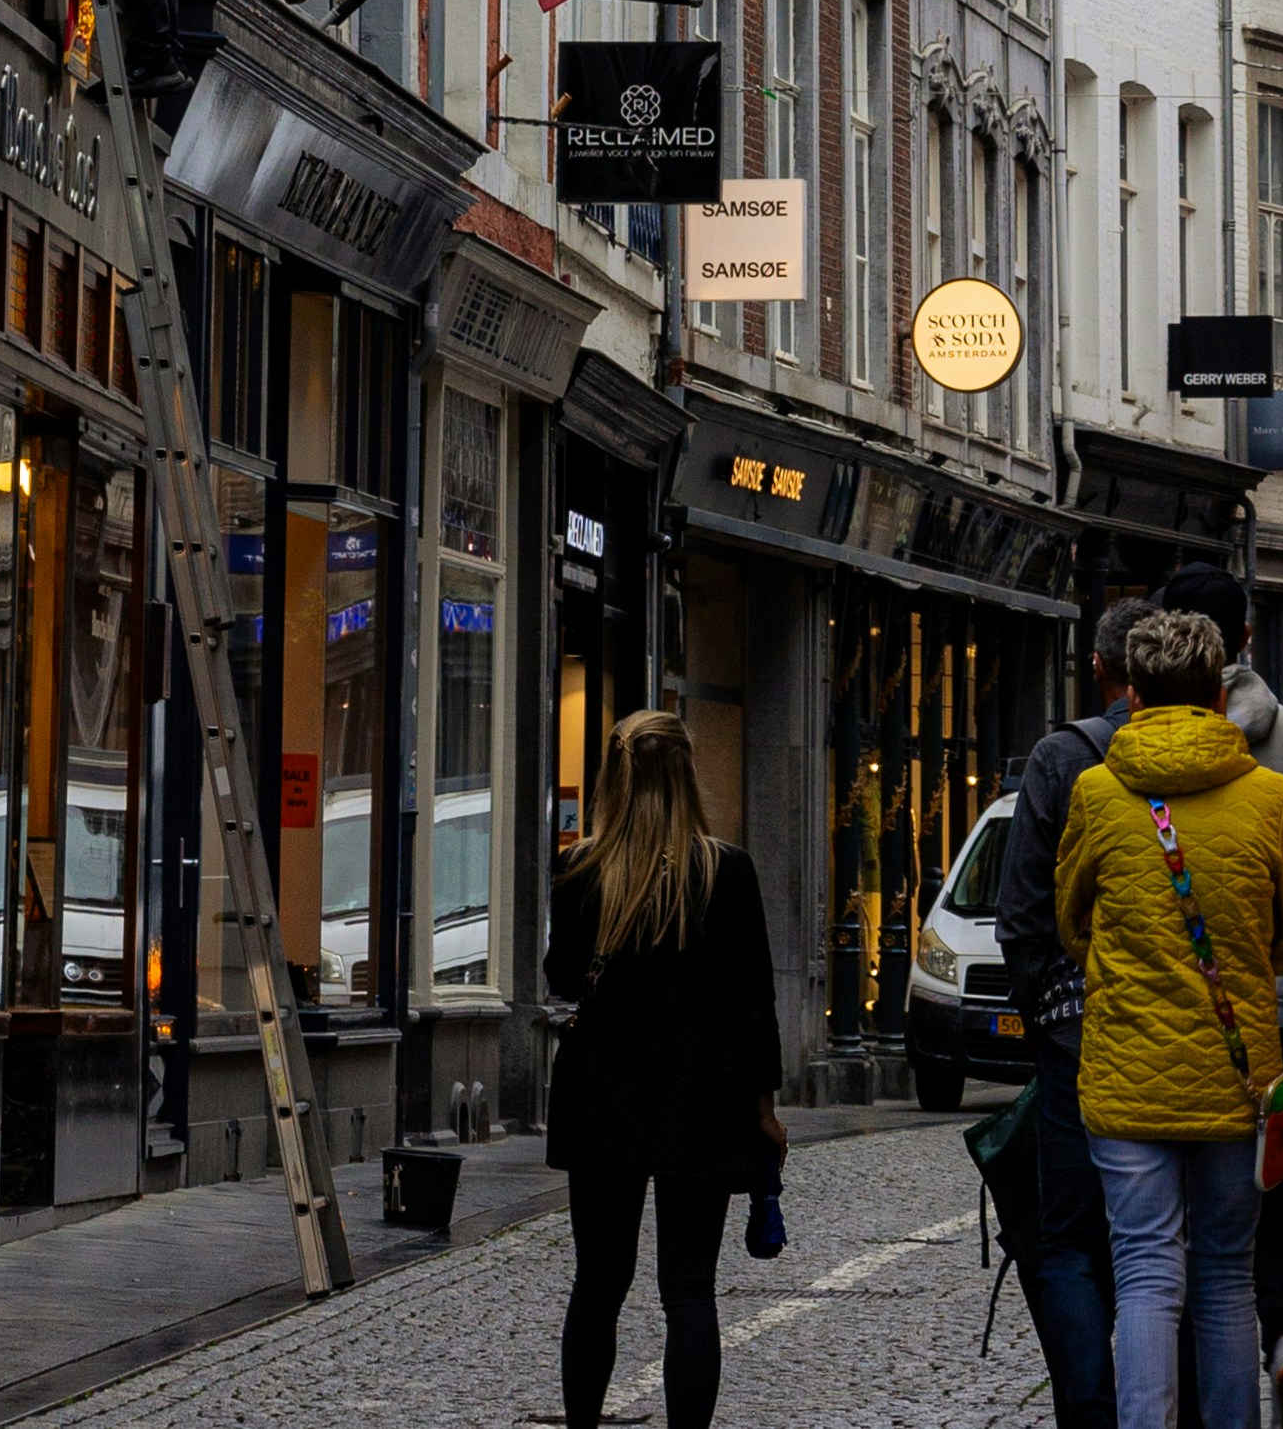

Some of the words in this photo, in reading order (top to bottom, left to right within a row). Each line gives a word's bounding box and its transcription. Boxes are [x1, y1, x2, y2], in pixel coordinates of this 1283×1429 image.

[669, 149, 683, 159] en
[701, 200, 789, 219] SAMSØE
[701, 261, 788, 279] SAMSØE
[927, 314, 1006, 330] SCOTCH
[952, 331, 1006, 347] SODA
[928, 349, 1008, 359] AMSTERDAM
[1183, 373, 1223, 386] GERRY
[1224, 373, 1268, 385] WEBER
[1252, 425, 1279, 436] Marc
